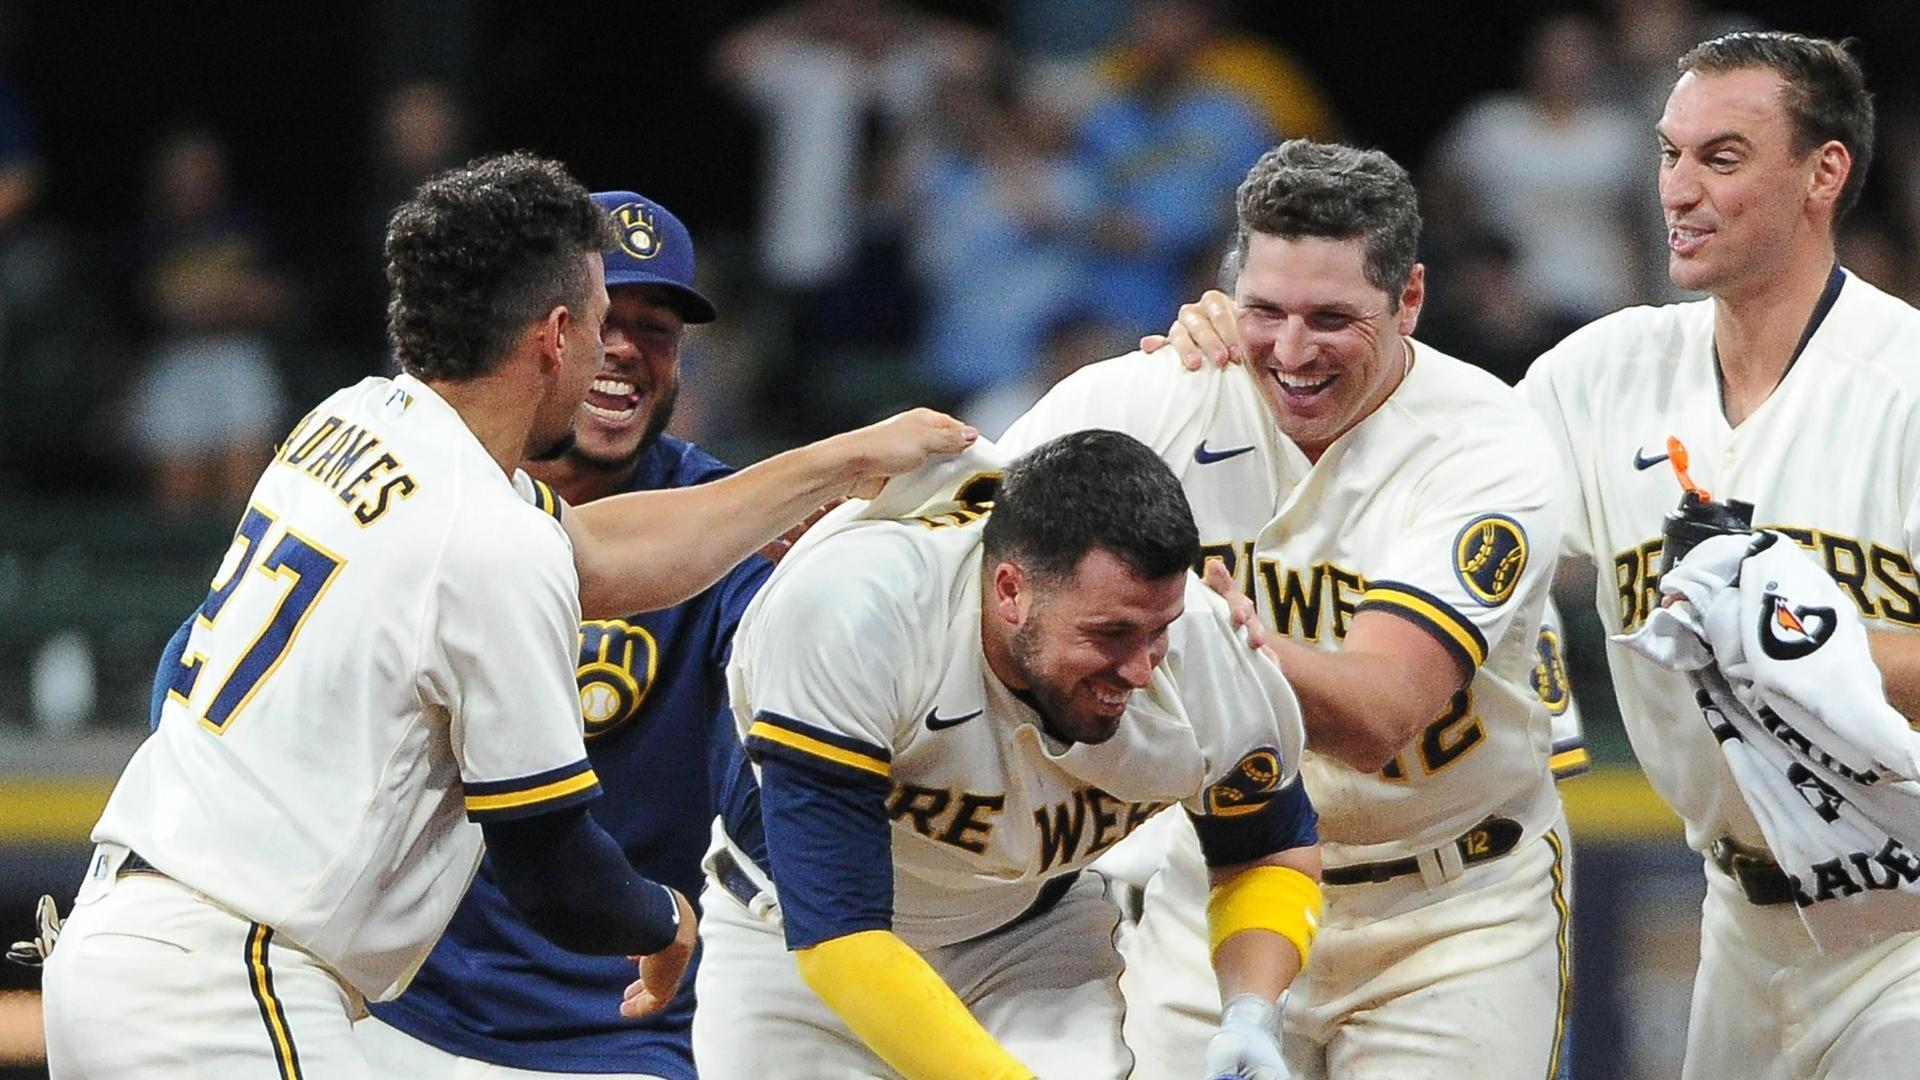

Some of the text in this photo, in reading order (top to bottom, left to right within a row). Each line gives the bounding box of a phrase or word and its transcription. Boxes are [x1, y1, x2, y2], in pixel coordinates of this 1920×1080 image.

[276, 411, 420, 529] ADAMES
[168, 500, 349, 736] 27
[1379, 685, 1488, 783] 2
[1464, 830, 1490, 855] 12
